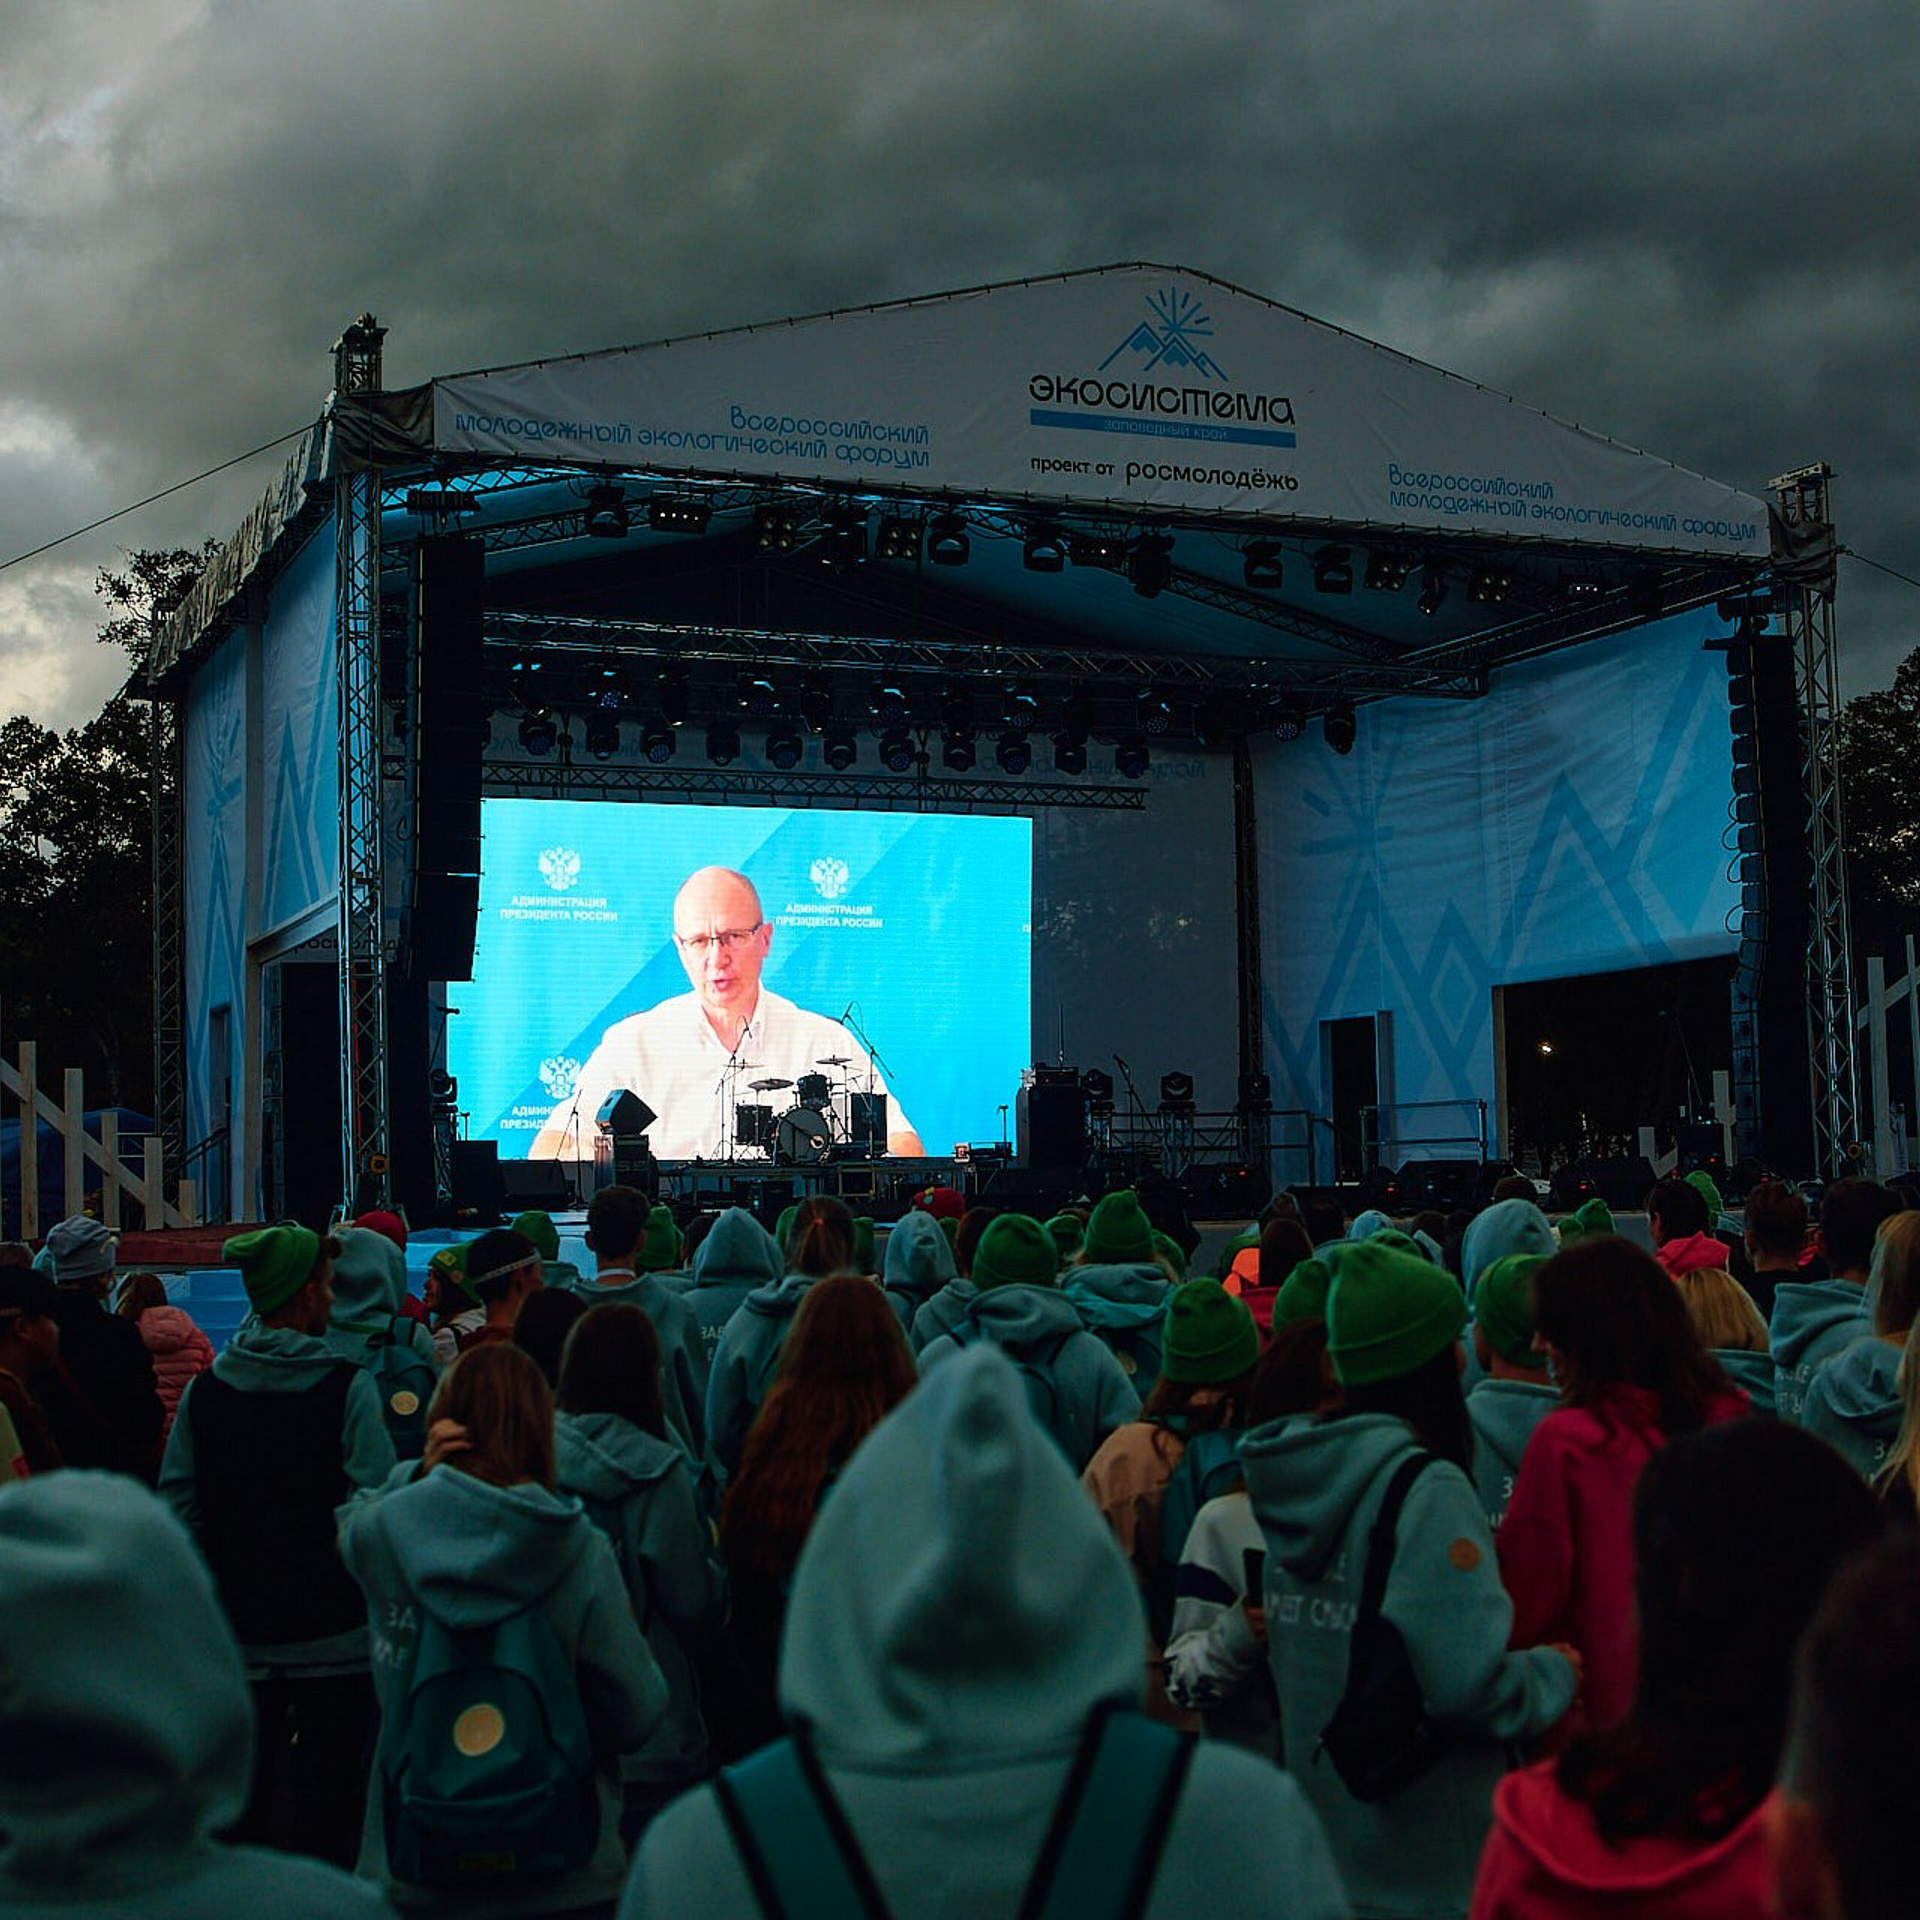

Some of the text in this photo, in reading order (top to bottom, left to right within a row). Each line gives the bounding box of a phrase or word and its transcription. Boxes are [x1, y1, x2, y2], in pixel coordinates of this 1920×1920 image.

[455, 413, 930, 470] молодежный экологический форум
[730, 406, 930, 445] Всероссийский
[1031, 457, 1299, 492] проект от росмолодёжь
[1387, 463, 1554, 500] Всероссийский
[1389, 489, 1757, 541] молодежный экологический форум
[500, 908, 619, 922] ПРЕЗИДЕНТА РОССИИ
[511, 895, 608, 909] АДМИНИСТРАЦИЯ
[785, 903, 873, 915] АДМИНИСТРАЦИЯ
[776, 915, 884, 928] ПРЕЗИДЕНТА РОССИИ
